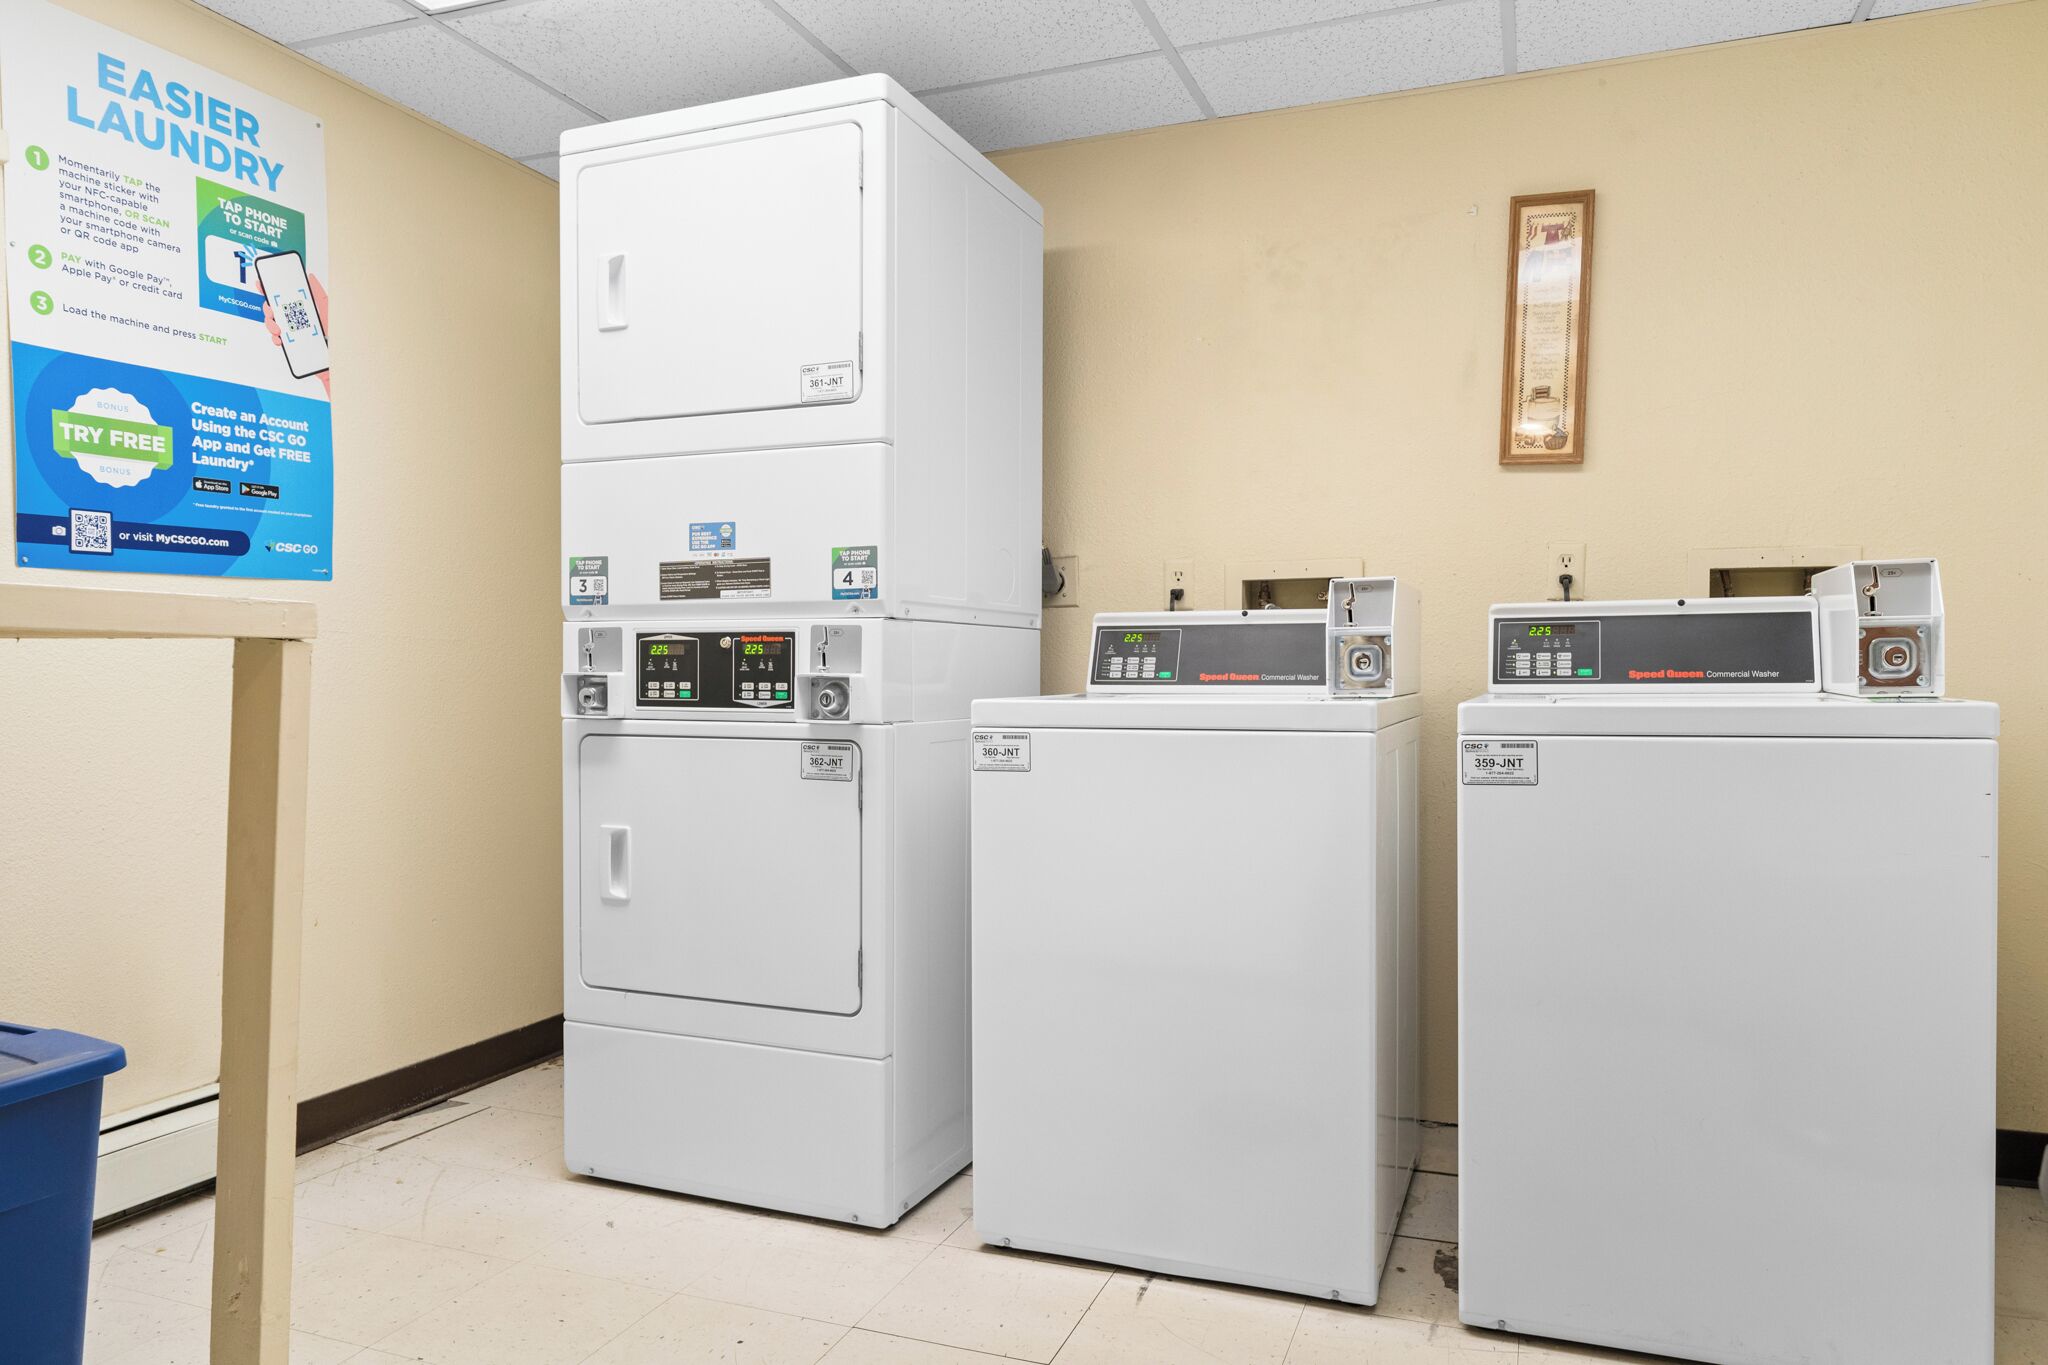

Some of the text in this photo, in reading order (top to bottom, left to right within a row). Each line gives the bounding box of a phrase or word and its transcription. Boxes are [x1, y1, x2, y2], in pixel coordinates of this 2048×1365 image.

[98, 52, 260, 148] EASIER
[67, 85, 284, 192] LAUNDRY
[33, 151, 160, 192] 1 Momentarily TAP the
[59, 168, 159, 203] machine sticker with
[59, 180, 148, 211] your NFC-capable
[60, 191, 170, 228] smartphone, OR SCAN
[69, 206, 110, 223] machine
[114, 218, 137, 230] code
[141, 226, 160, 237] with
[217, 197, 287, 229] TAP PHONE
[224, 211, 283, 239] TO START
[60, 215, 181, 253] your smartphone camera
[60, 226, 139, 253] or QR code app
[238, 231, 253, 240] scan
[254, 236, 269, 245] code
[35, 249, 46, 265] 2
[61, 252, 82, 264] PAY
[85, 259, 106, 270] with
[109, 265, 143, 279] Google
[234, 251, 246, 284] 1
[62, 264, 91, 278] Apple
[119, 278, 129, 287] or
[132, 282, 160, 294] credit
[162, 288, 183, 300] card
[218, 295, 261, 312] MyCSCGO.com
[36, 296, 228, 346] 3 Load the machine and press START
[810, 377, 844, 387] 361-JNT
[96, 401, 129, 413] BONUS
[191, 401, 309, 432] Create an Account
[59, 422, 166, 453] TRY FREE
[191, 418, 306, 446] Using the CSC GO
[192, 435, 311, 463] App and Get FREE
[99, 466, 131, 476] BONUS
[133, 532, 153, 542] visit
[156, 534, 229, 547] MyCSCGO.com
[275, 542, 318, 554] CSC GO
[579, 580, 587, 592] 3
[843, 571, 853, 585] 4
[1124, 634, 1142, 642] 2.25
[1529, 626, 1551, 636] 2.25
[1200, 673, 1228, 682] Speed
[1628, 670, 1779, 680] Speed Queen Commercial Washer
[810, 757, 843, 766] 362-JNT
[982, 748, 1020, 756] 360-JNT
[1475, 758, 1524, 768] 359-JNT
